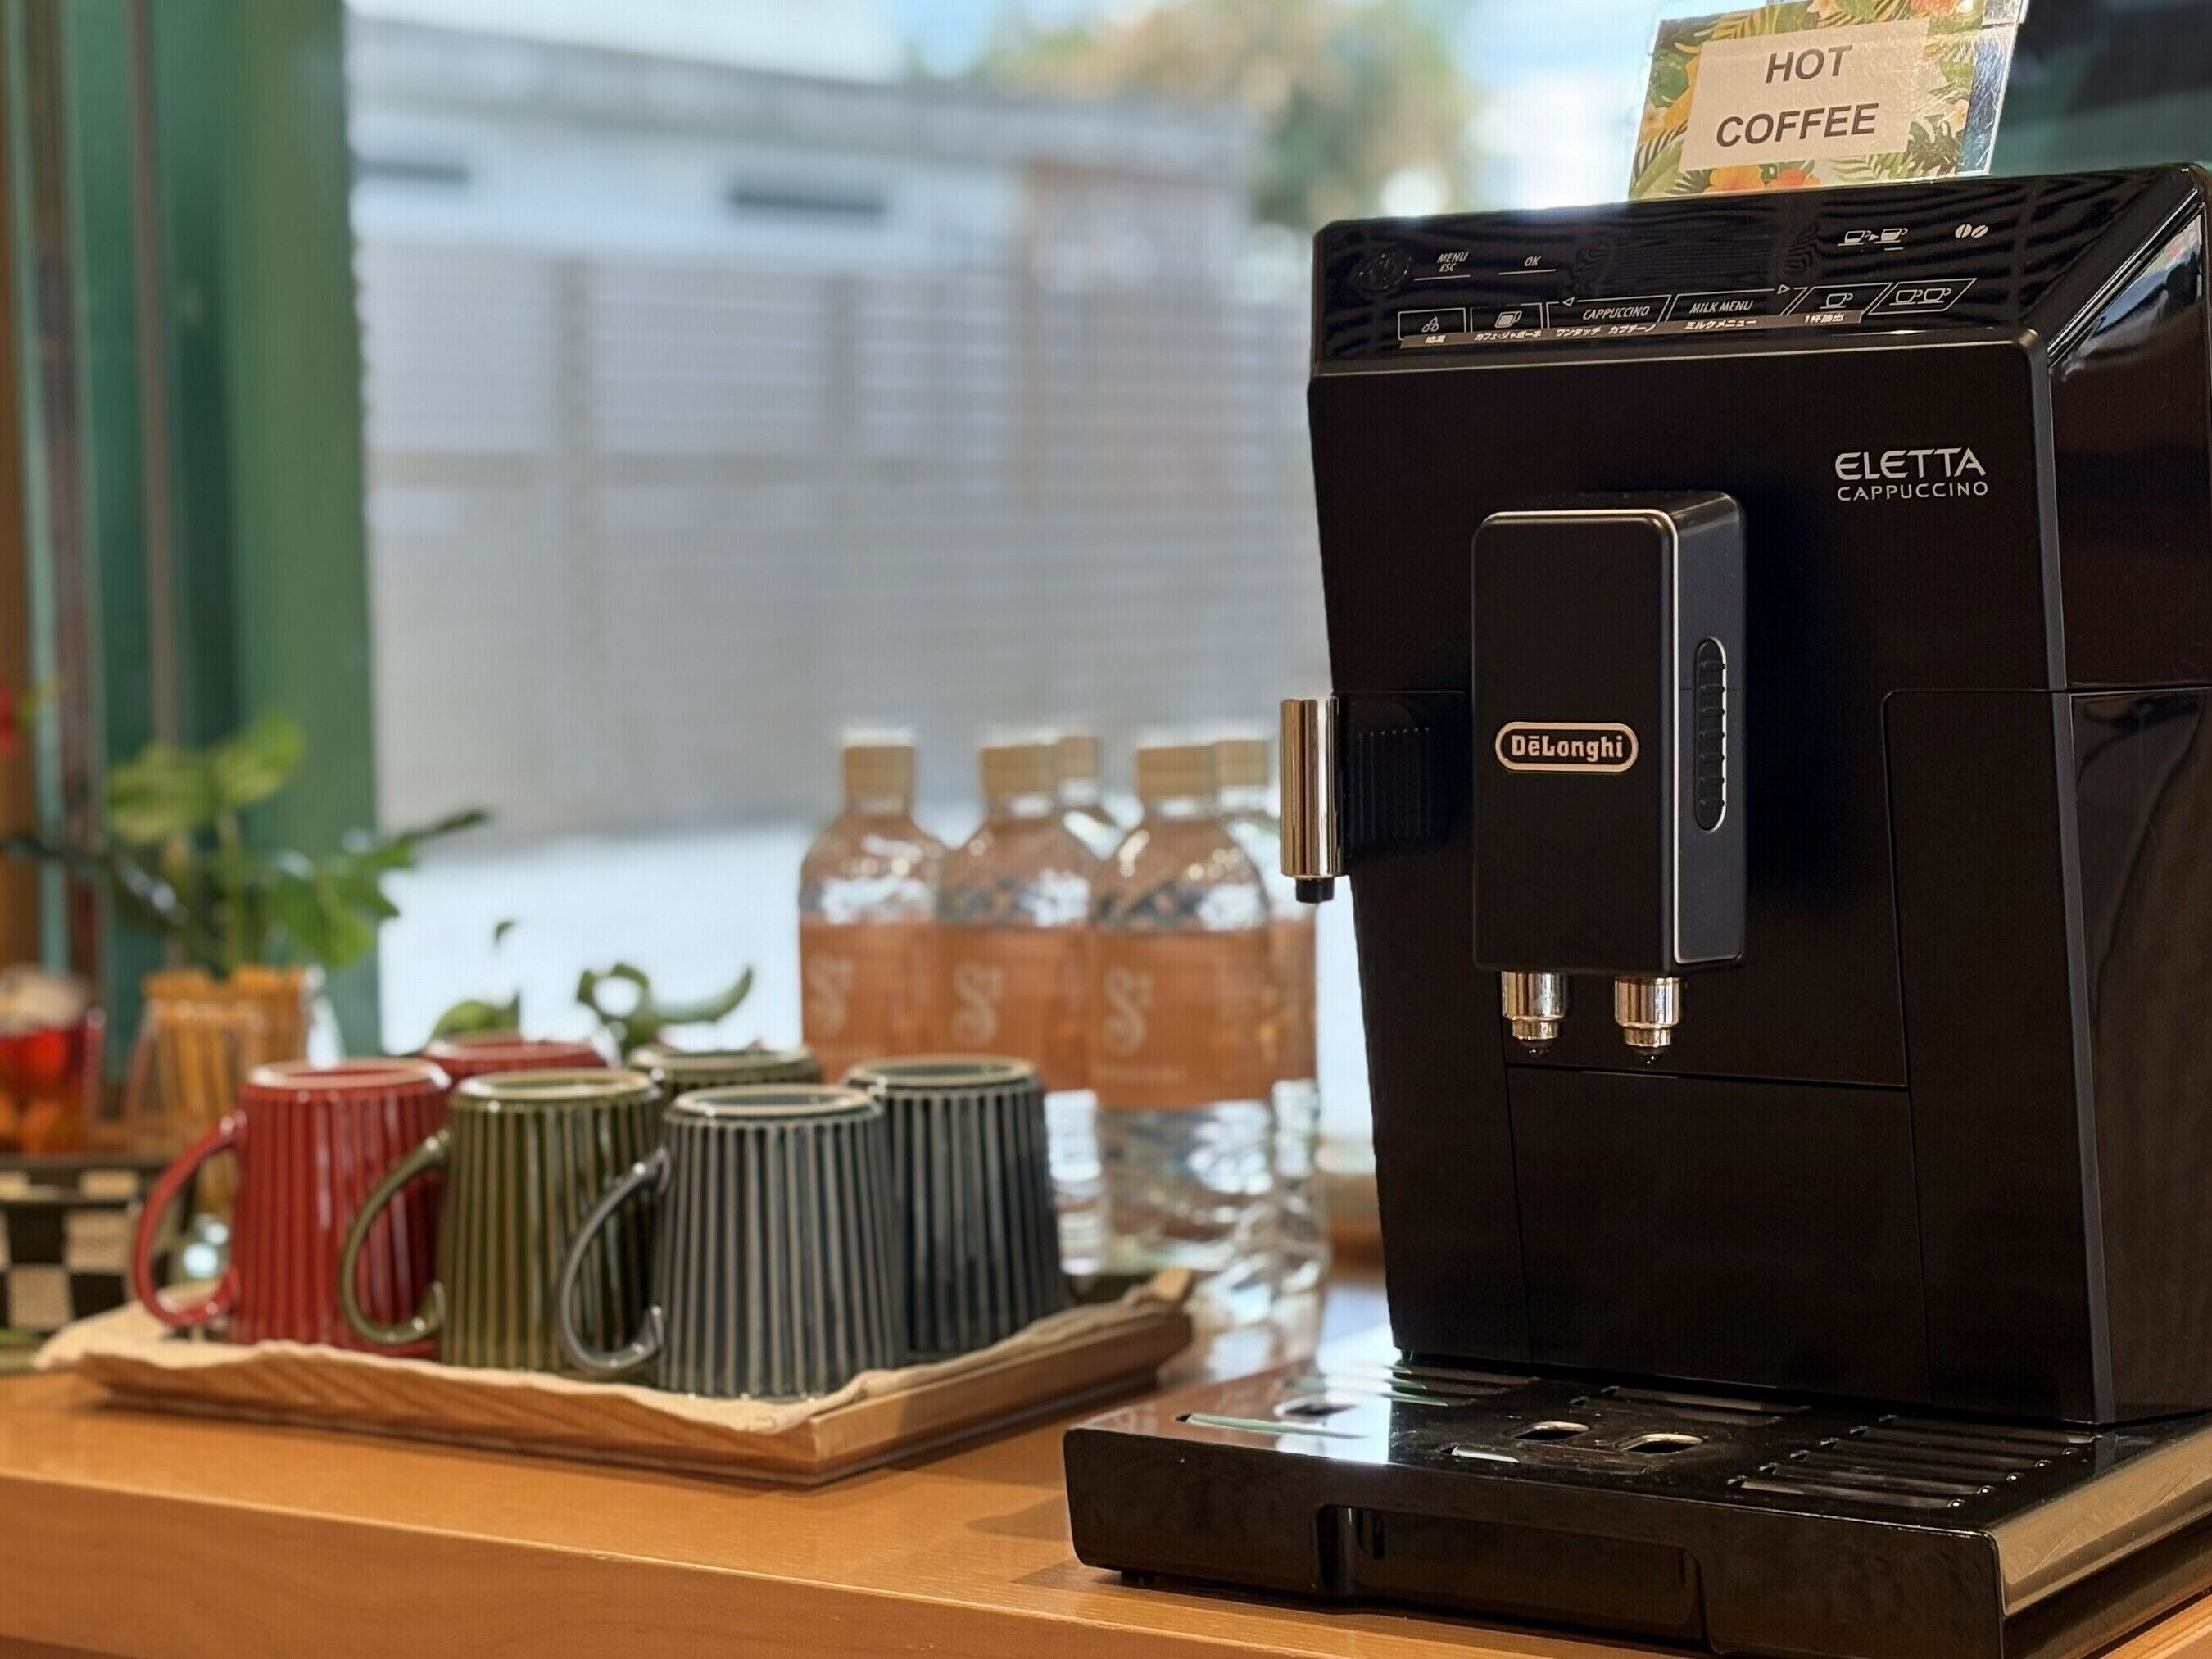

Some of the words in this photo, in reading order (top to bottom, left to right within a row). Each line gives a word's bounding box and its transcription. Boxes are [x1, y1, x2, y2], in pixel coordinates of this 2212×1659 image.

[1766, 45, 1852, 84] HOT
[1716, 102, 1879, 147] COFFEE
[1437, 252, 1469, 264] MENU
[1524, 256, 1542, 267] OK
[1439, 262, 1457, 273] ESC
[1582, 305, 1651, 321] CAPPUCCINO
[1689, 301, 1719, 315] MILK
[1718, 300, 1754, 313] MENU
[1684, 320, 1757, 330] ミルクメニュー
[1835, 447, 1987, 481] ELETTA
[1837, 481, 1989, 501] CAPPUCCINO
